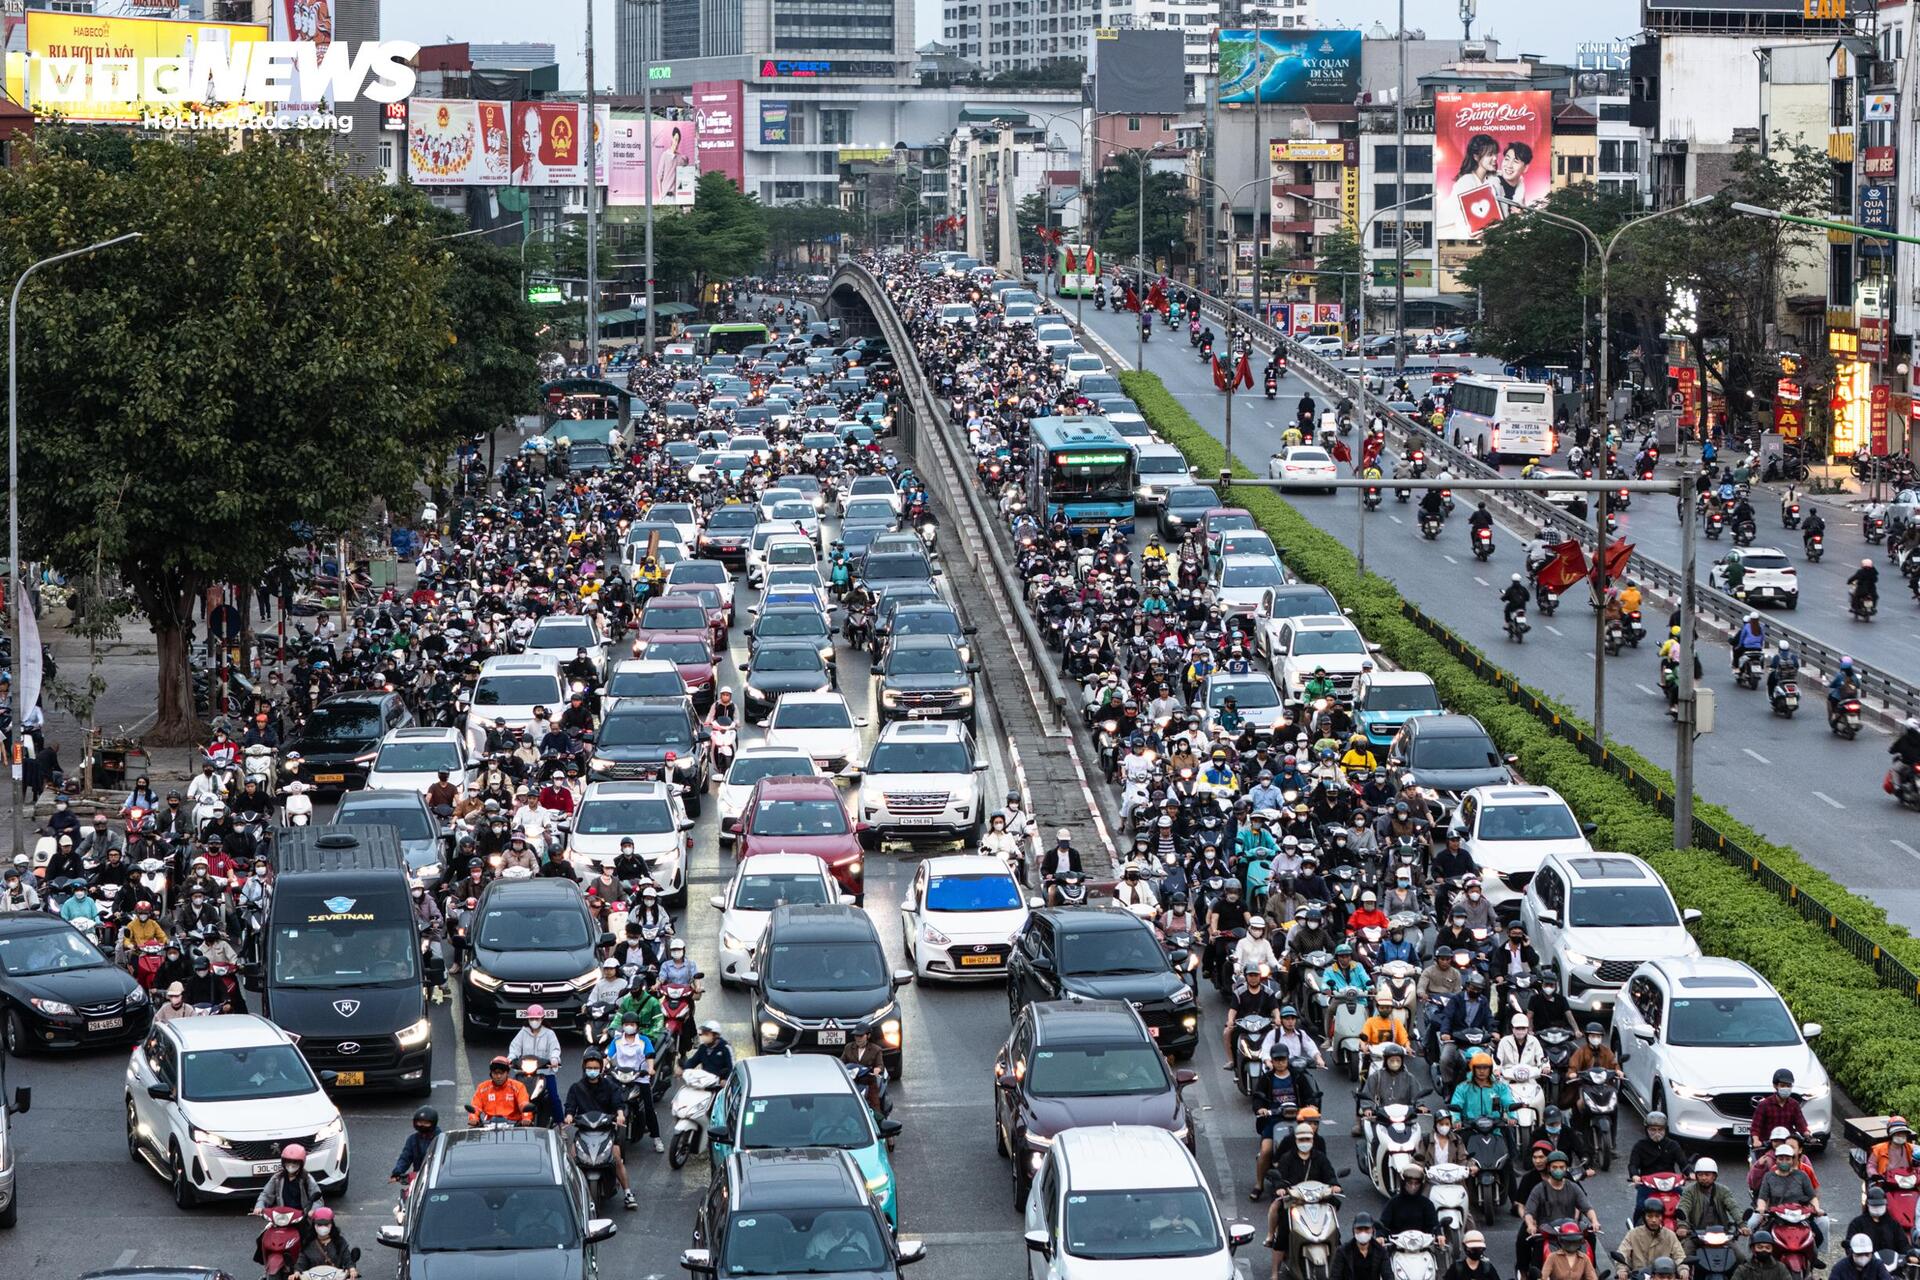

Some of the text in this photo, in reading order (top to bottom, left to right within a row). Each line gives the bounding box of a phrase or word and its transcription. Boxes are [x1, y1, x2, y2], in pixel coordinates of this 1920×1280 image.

[73, 26, 103, 37] HABECO
[49, 44, 68, 58] BIA
[95, 42, 110, 58] HÀ
[1577, 40, 1607, 53] KÍNH
[778, 61, 829, 71] CYBER
[1319, 59, 1349, 69] QUAN
[1579, 56, 1631, 70] LILY
[1310, 70, 1321, 78] DI
[1456, 107, 1496, 127] Đúng
